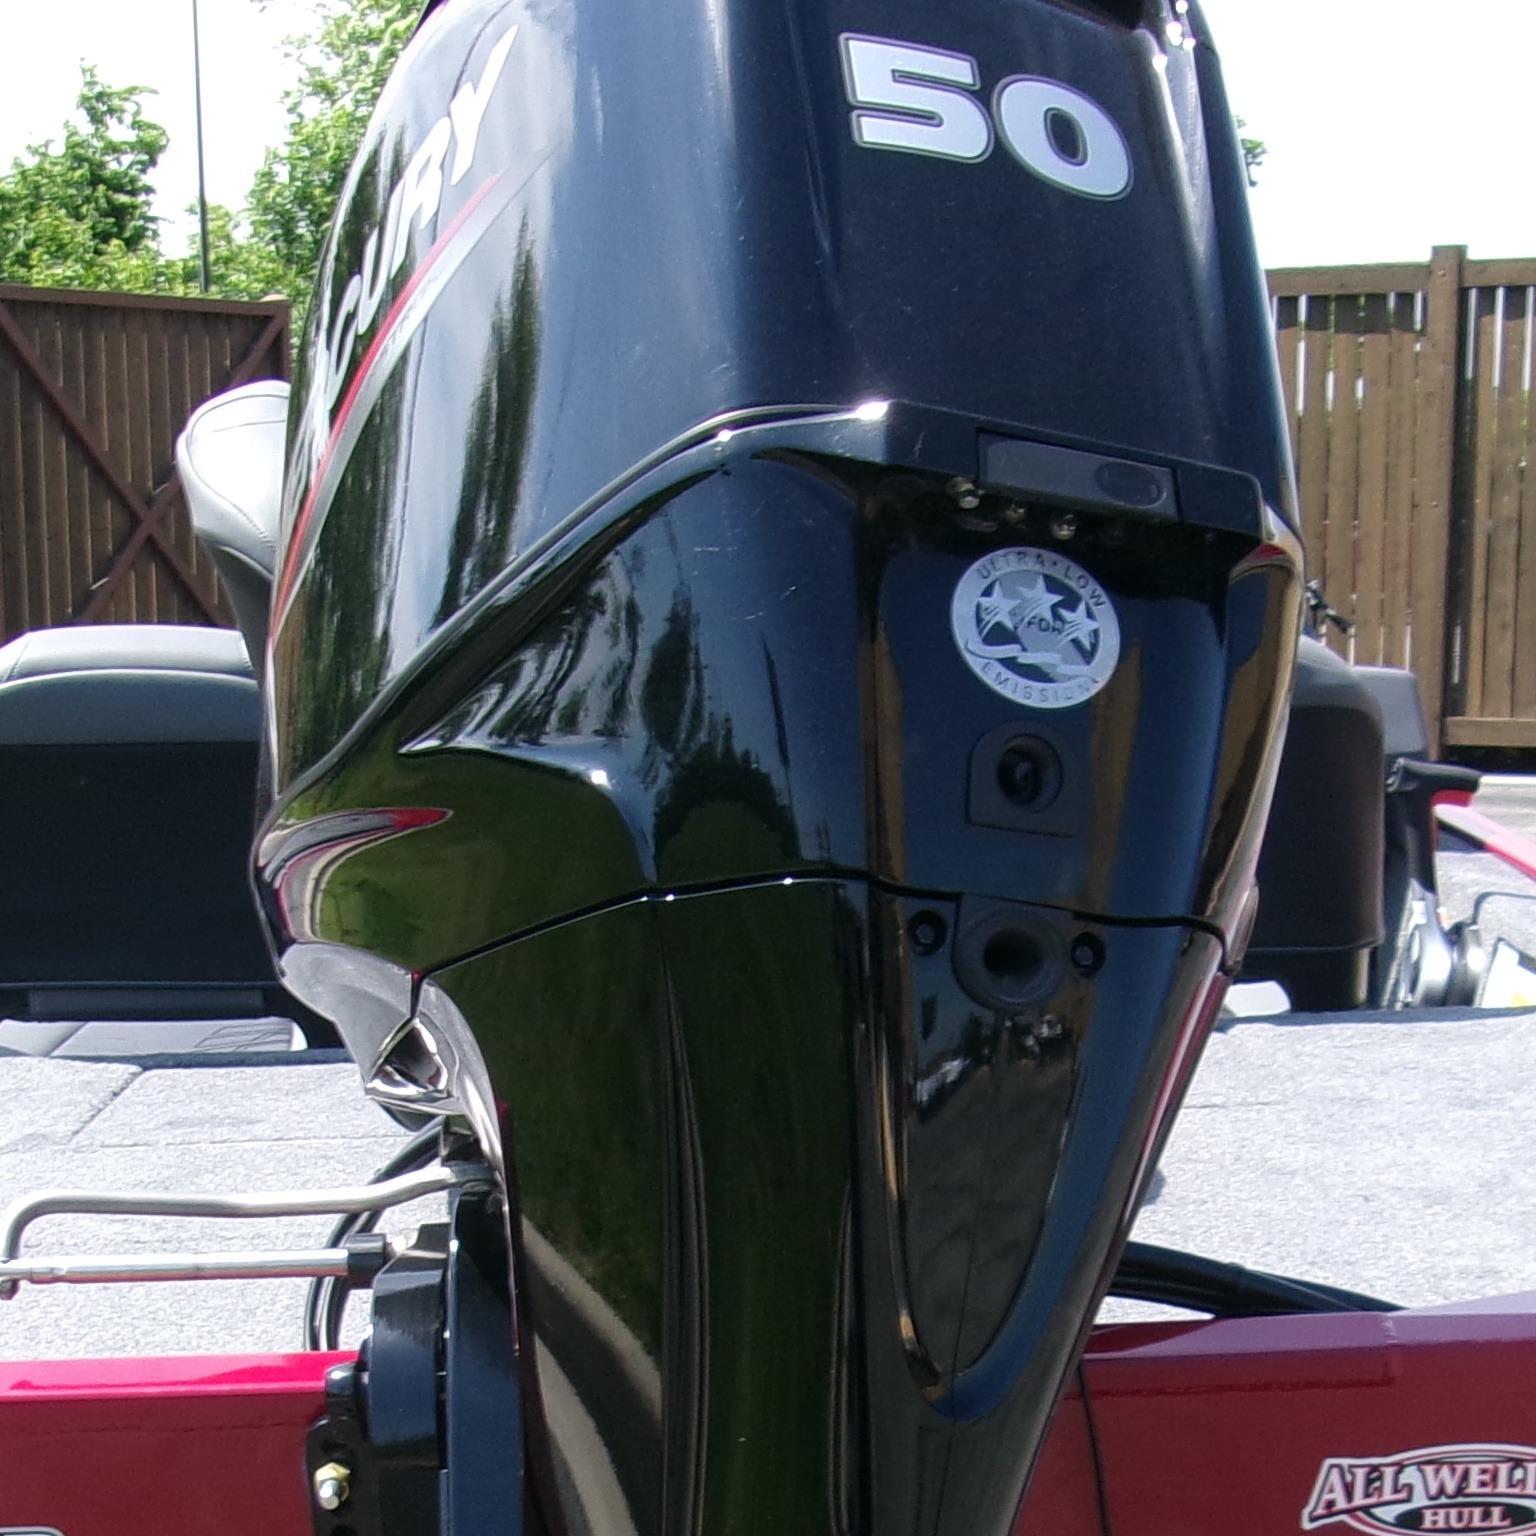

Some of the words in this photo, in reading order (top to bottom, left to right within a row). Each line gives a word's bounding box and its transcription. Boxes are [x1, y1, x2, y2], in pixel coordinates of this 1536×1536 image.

[839, 32, 1134, 201] 50
[977, 552, 1047, 579] ULTRA
[1063, 565, 1108, 608] LOW
[1311, 1461, 1411, 1520] ALL
[1421, 1506, 1512, 1530] HULL
